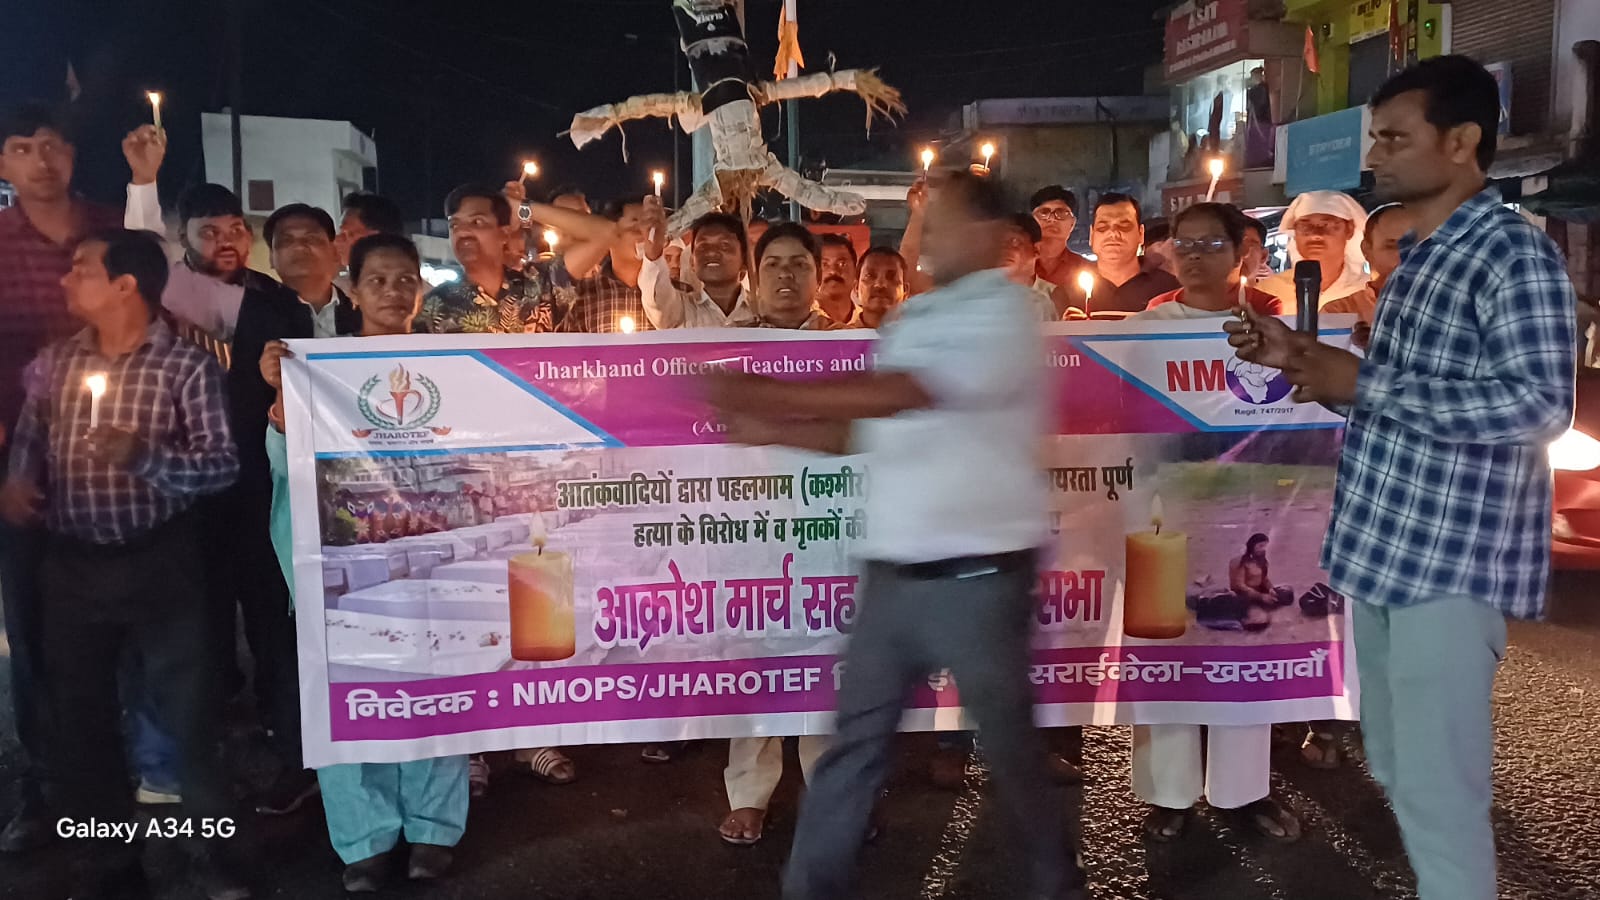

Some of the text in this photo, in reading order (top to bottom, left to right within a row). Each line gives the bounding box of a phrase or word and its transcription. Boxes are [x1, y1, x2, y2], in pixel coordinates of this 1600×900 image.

[534, 358, 645, 380] Jharkhand
[739, 355, 824, 374] Teachers
[830, 353, 866, 372] and
[373, 431, 430, 440] JHAROTEF
[557, 470, 674, 508] आतंकवादियों
[676, 477, 713, 503] द्वारा
[716, 474, 794, 502] पहलगाम
[1101, 457, 1134, 501] पूर्ण
[632, 522, 674, 548] हत्या
[676, 513, 695, 546] के
[699, 512, 750, 546] विरोध
[753, 510, 771, 543] में
[774, 518, 787, 542] व
[791, 508, 843, 550] मृतकों
[594, 559, 717, 651] आक्रोश
[724, 552, 794, 631] मार्च
[1036, 569, 1106, 626] सभा
[345, 688, 477, 721] निवेदक
[512, 667, 822, 707] NMOPS/JHAROTEF
